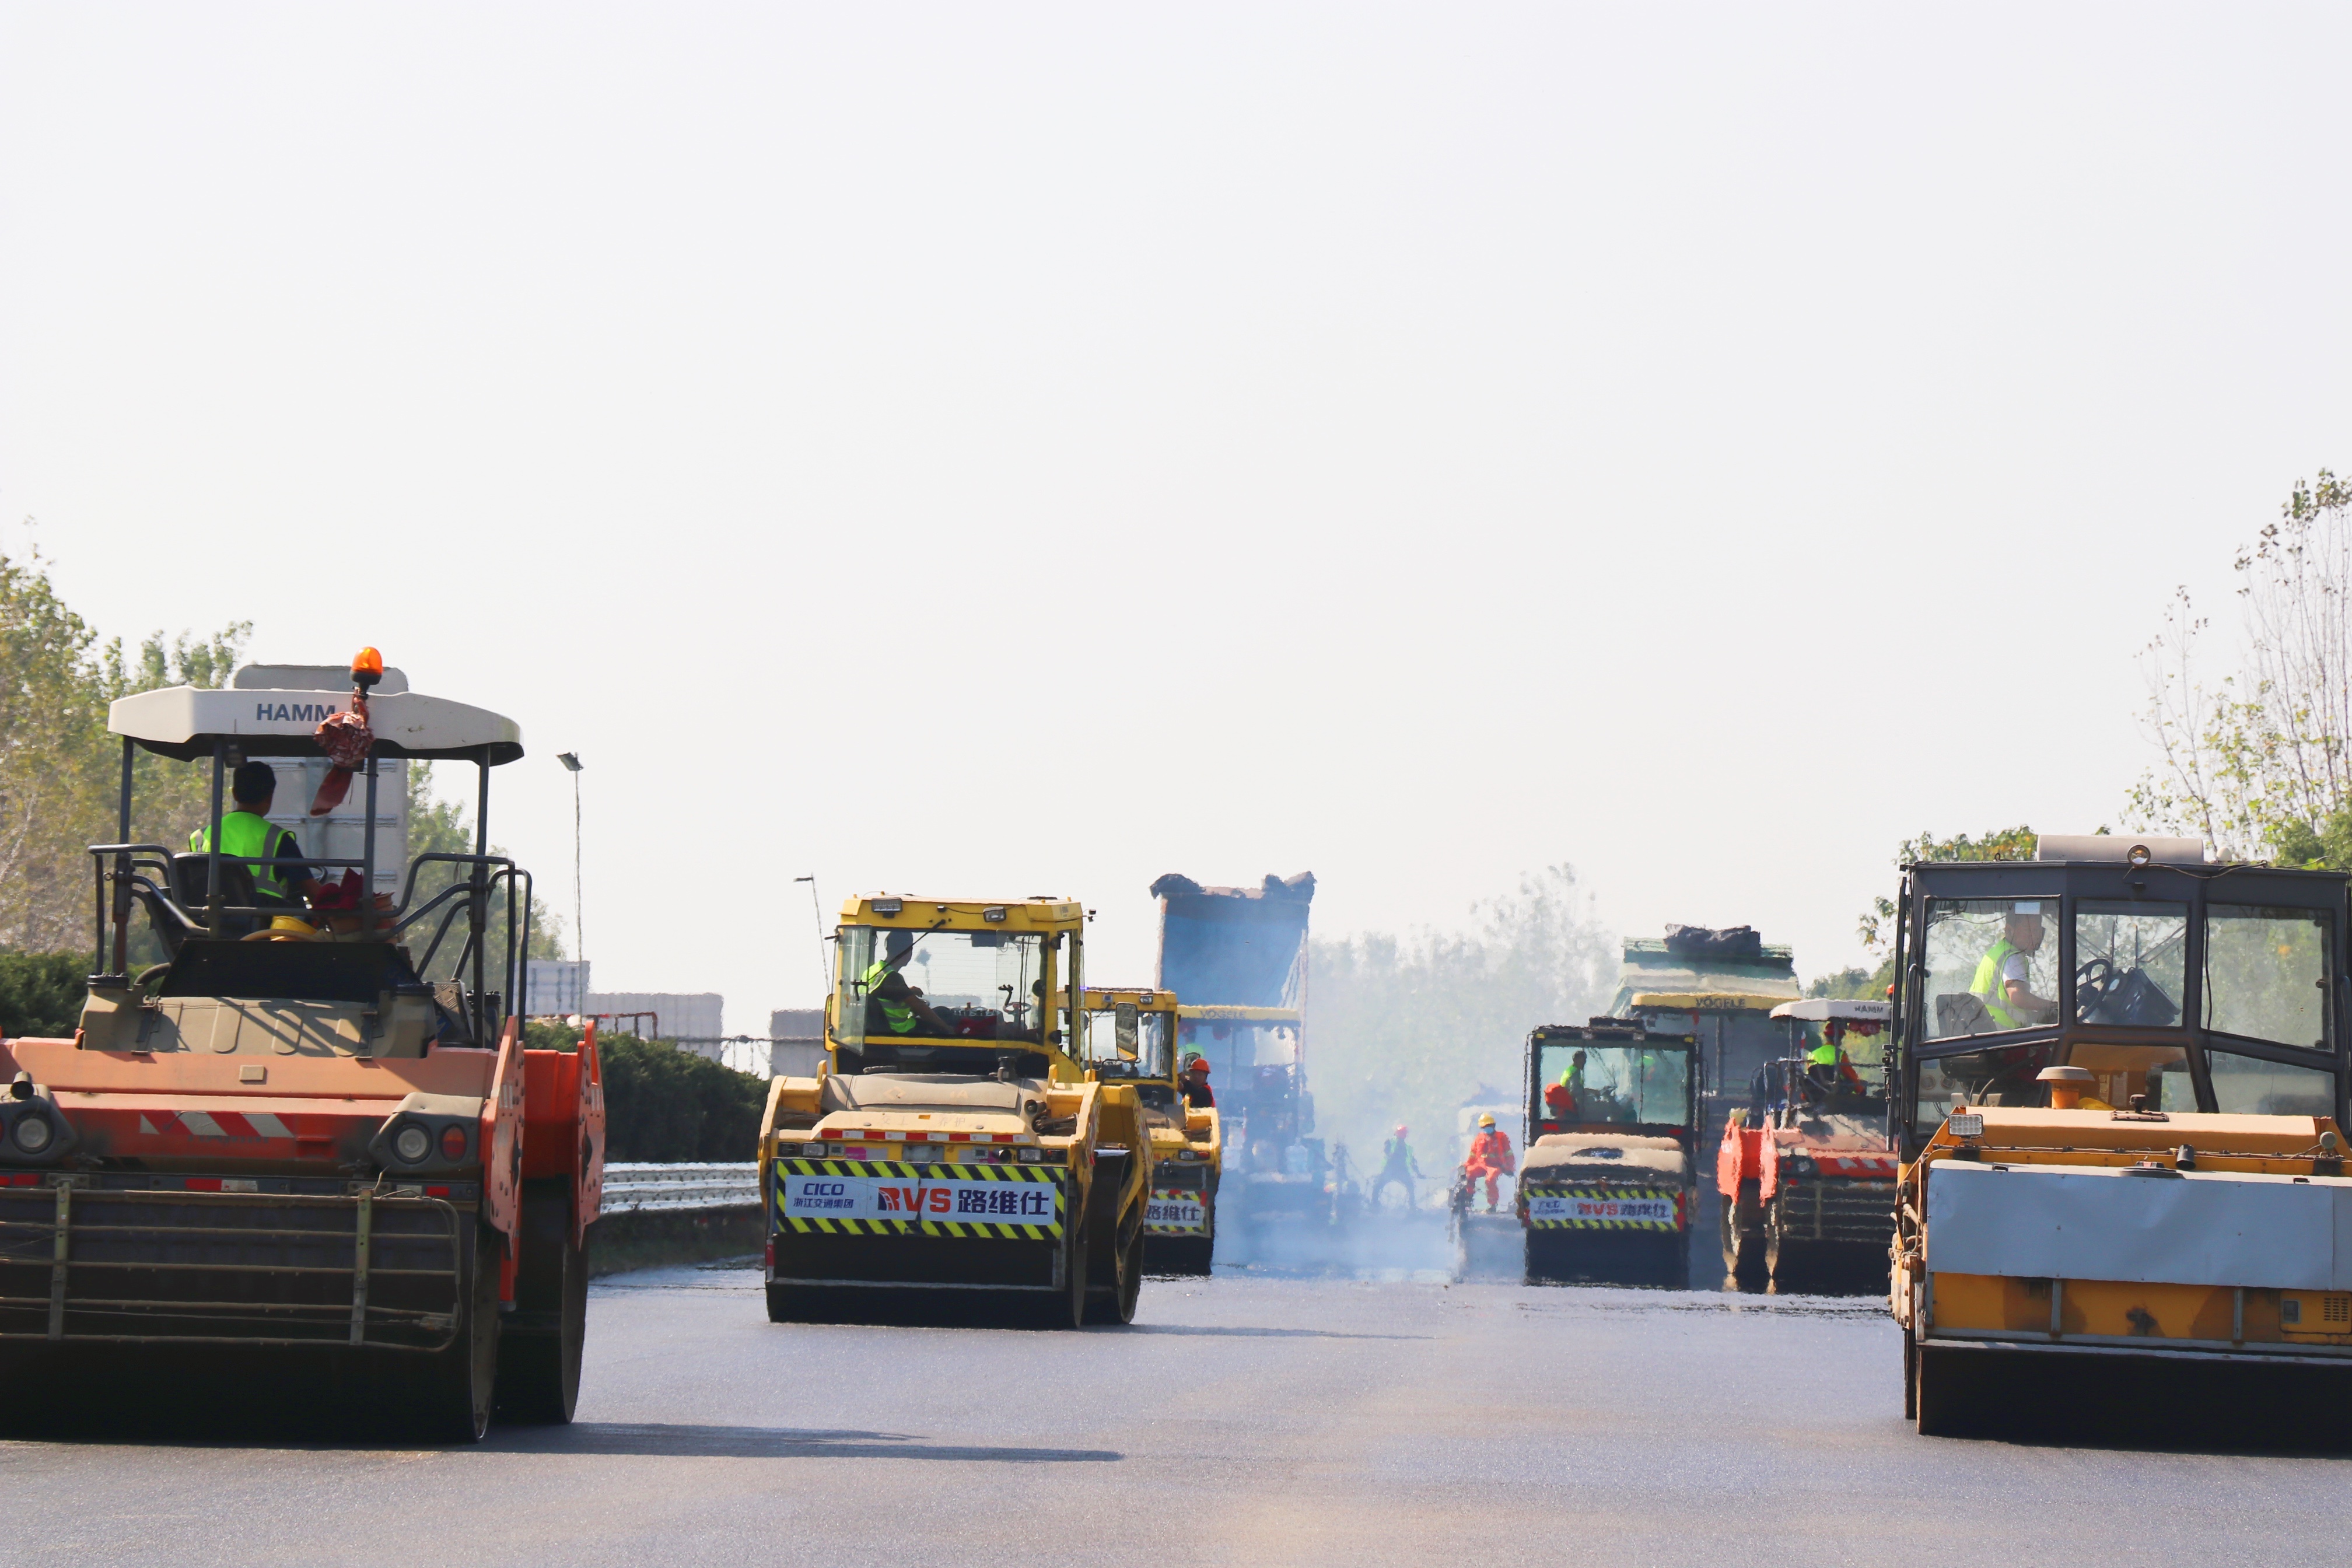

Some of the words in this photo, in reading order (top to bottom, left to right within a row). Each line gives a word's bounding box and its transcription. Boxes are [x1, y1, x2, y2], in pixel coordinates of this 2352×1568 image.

[256, 703, 335, 722] HAMM
[803, 1182, 845, 1196] CICO
[793, 1197, 854, 1209] 浙江交通集团
[877, 1186, 951, 1213] RVS
[957, 1189, 1050, 1216] 路维仕
